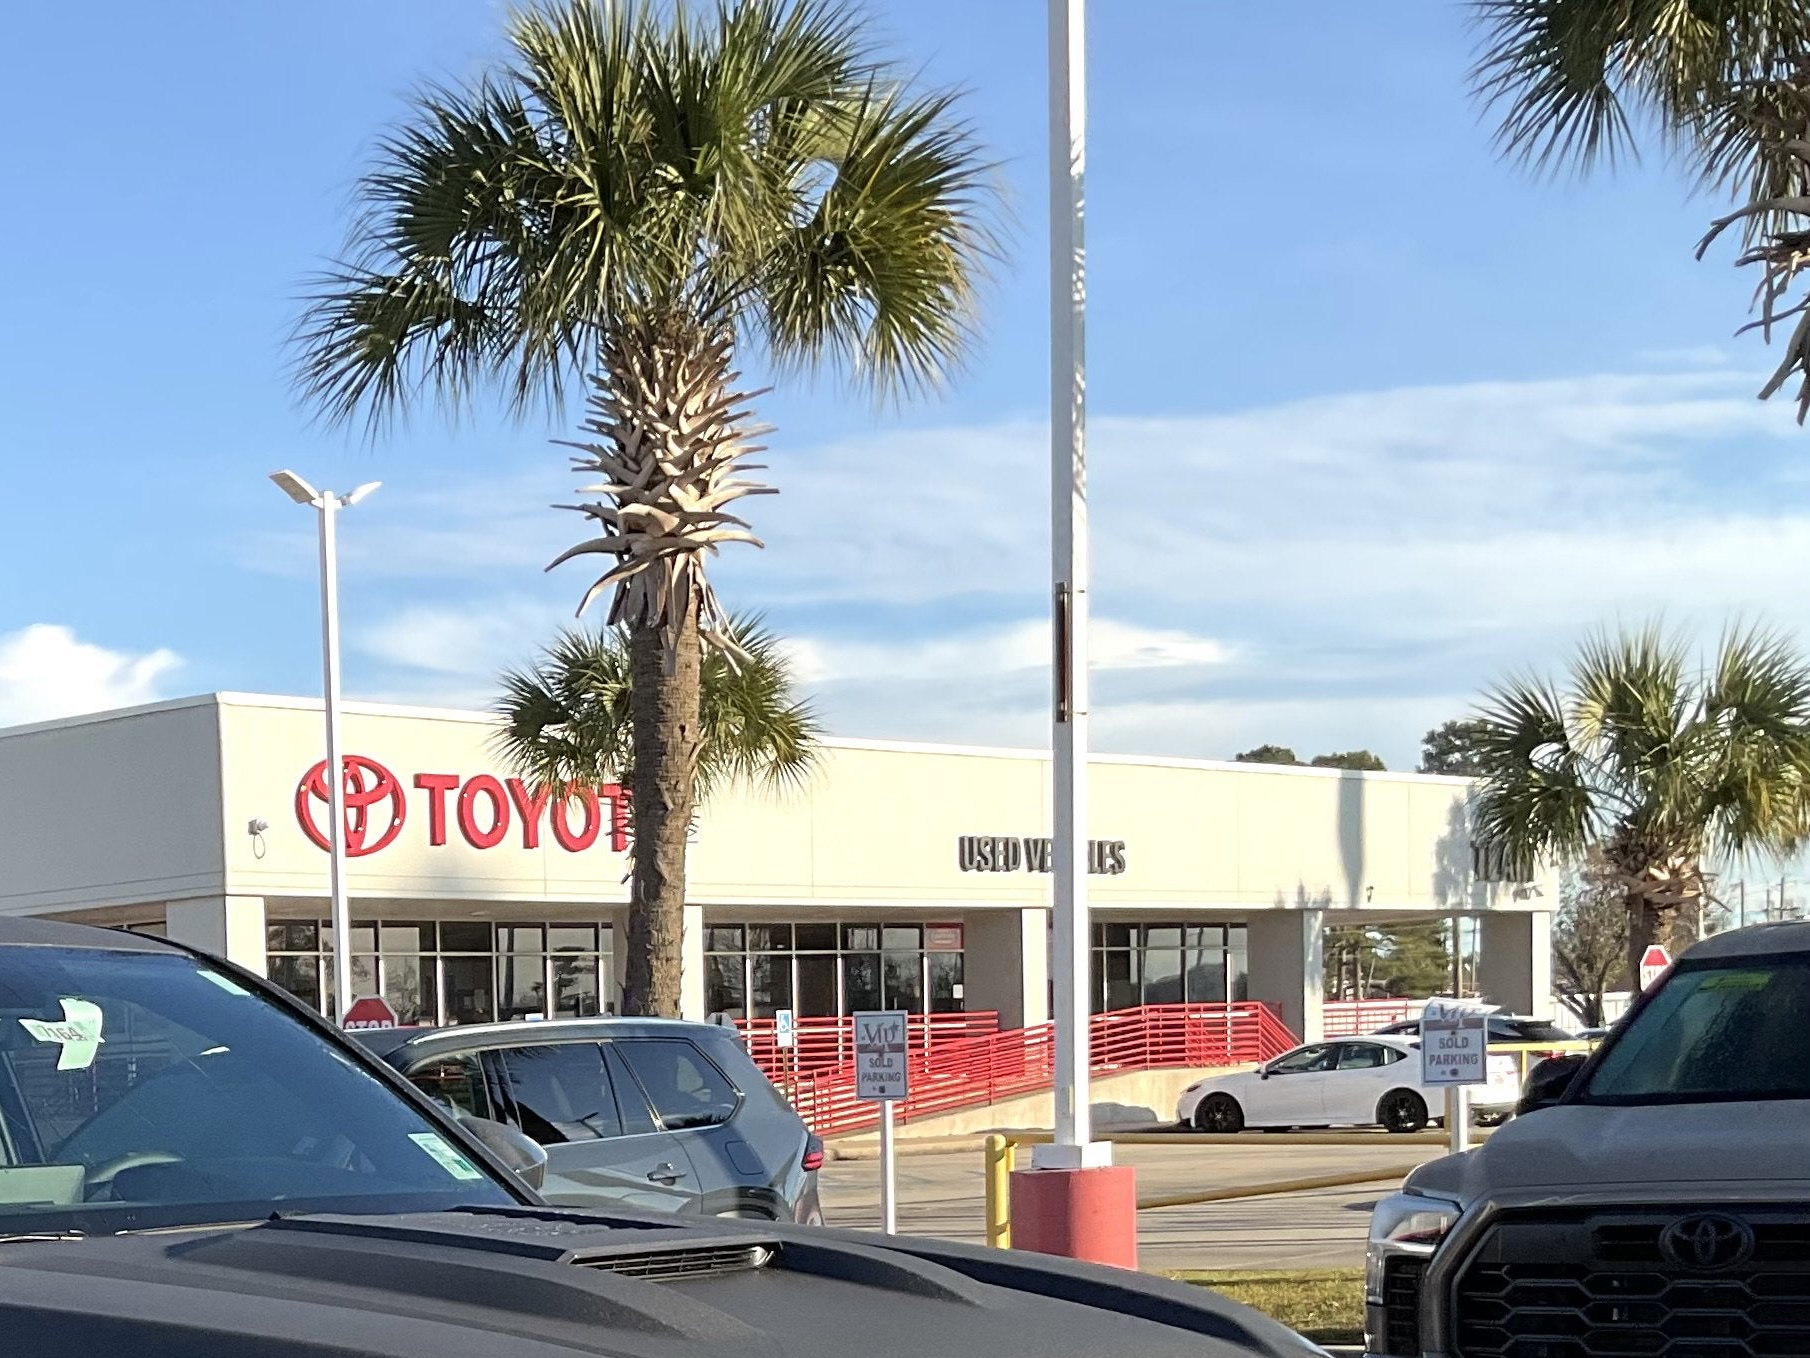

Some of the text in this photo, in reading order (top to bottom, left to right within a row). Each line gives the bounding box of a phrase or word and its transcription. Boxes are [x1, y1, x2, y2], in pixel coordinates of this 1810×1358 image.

[413, 772, 633, 853] TOYOT
[959, 836, 1126, 875] USED VELES
[1438, 1037, 1469, 1049] SOLD
[868, 1057, 893, 1068] SOLD
[1429, 1053, 1479, 1066] PARKING
[861, 1072, 901, 1082] PARKING
